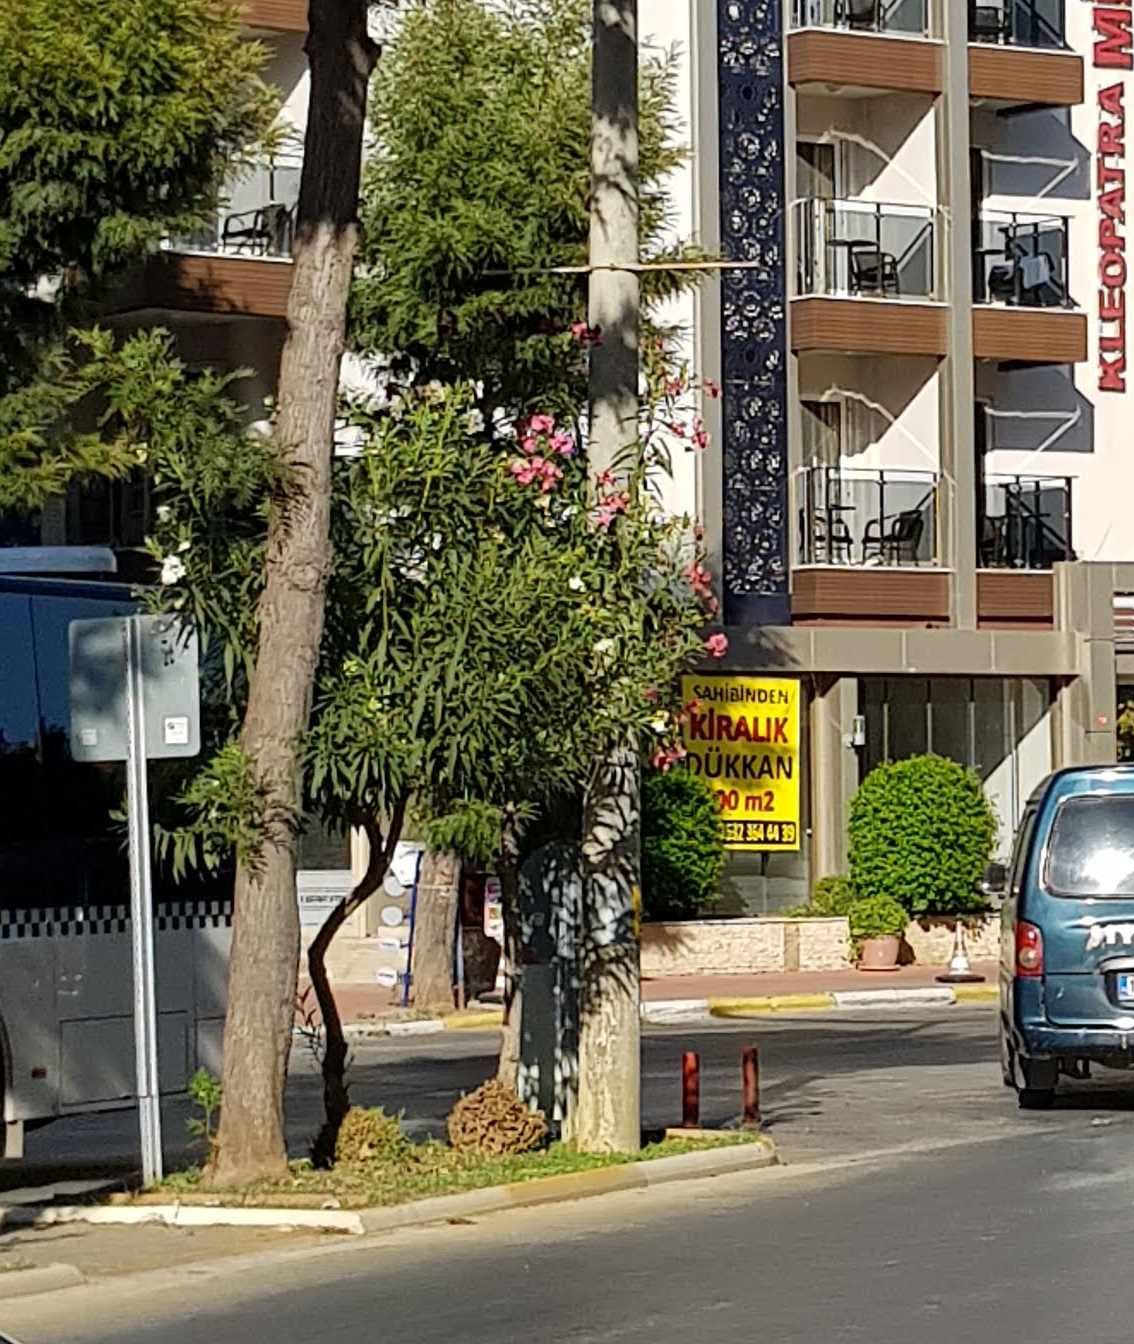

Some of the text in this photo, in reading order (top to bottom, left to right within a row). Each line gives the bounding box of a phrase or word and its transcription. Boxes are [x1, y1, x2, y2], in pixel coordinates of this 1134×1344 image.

[1097, 81, 1128, 394] KLEOPATRA
[690, 708, 788, 743] KİRALIK
[686, 746, 793, 780] DÜKKAN
[744, 790, 775, 812] m2
